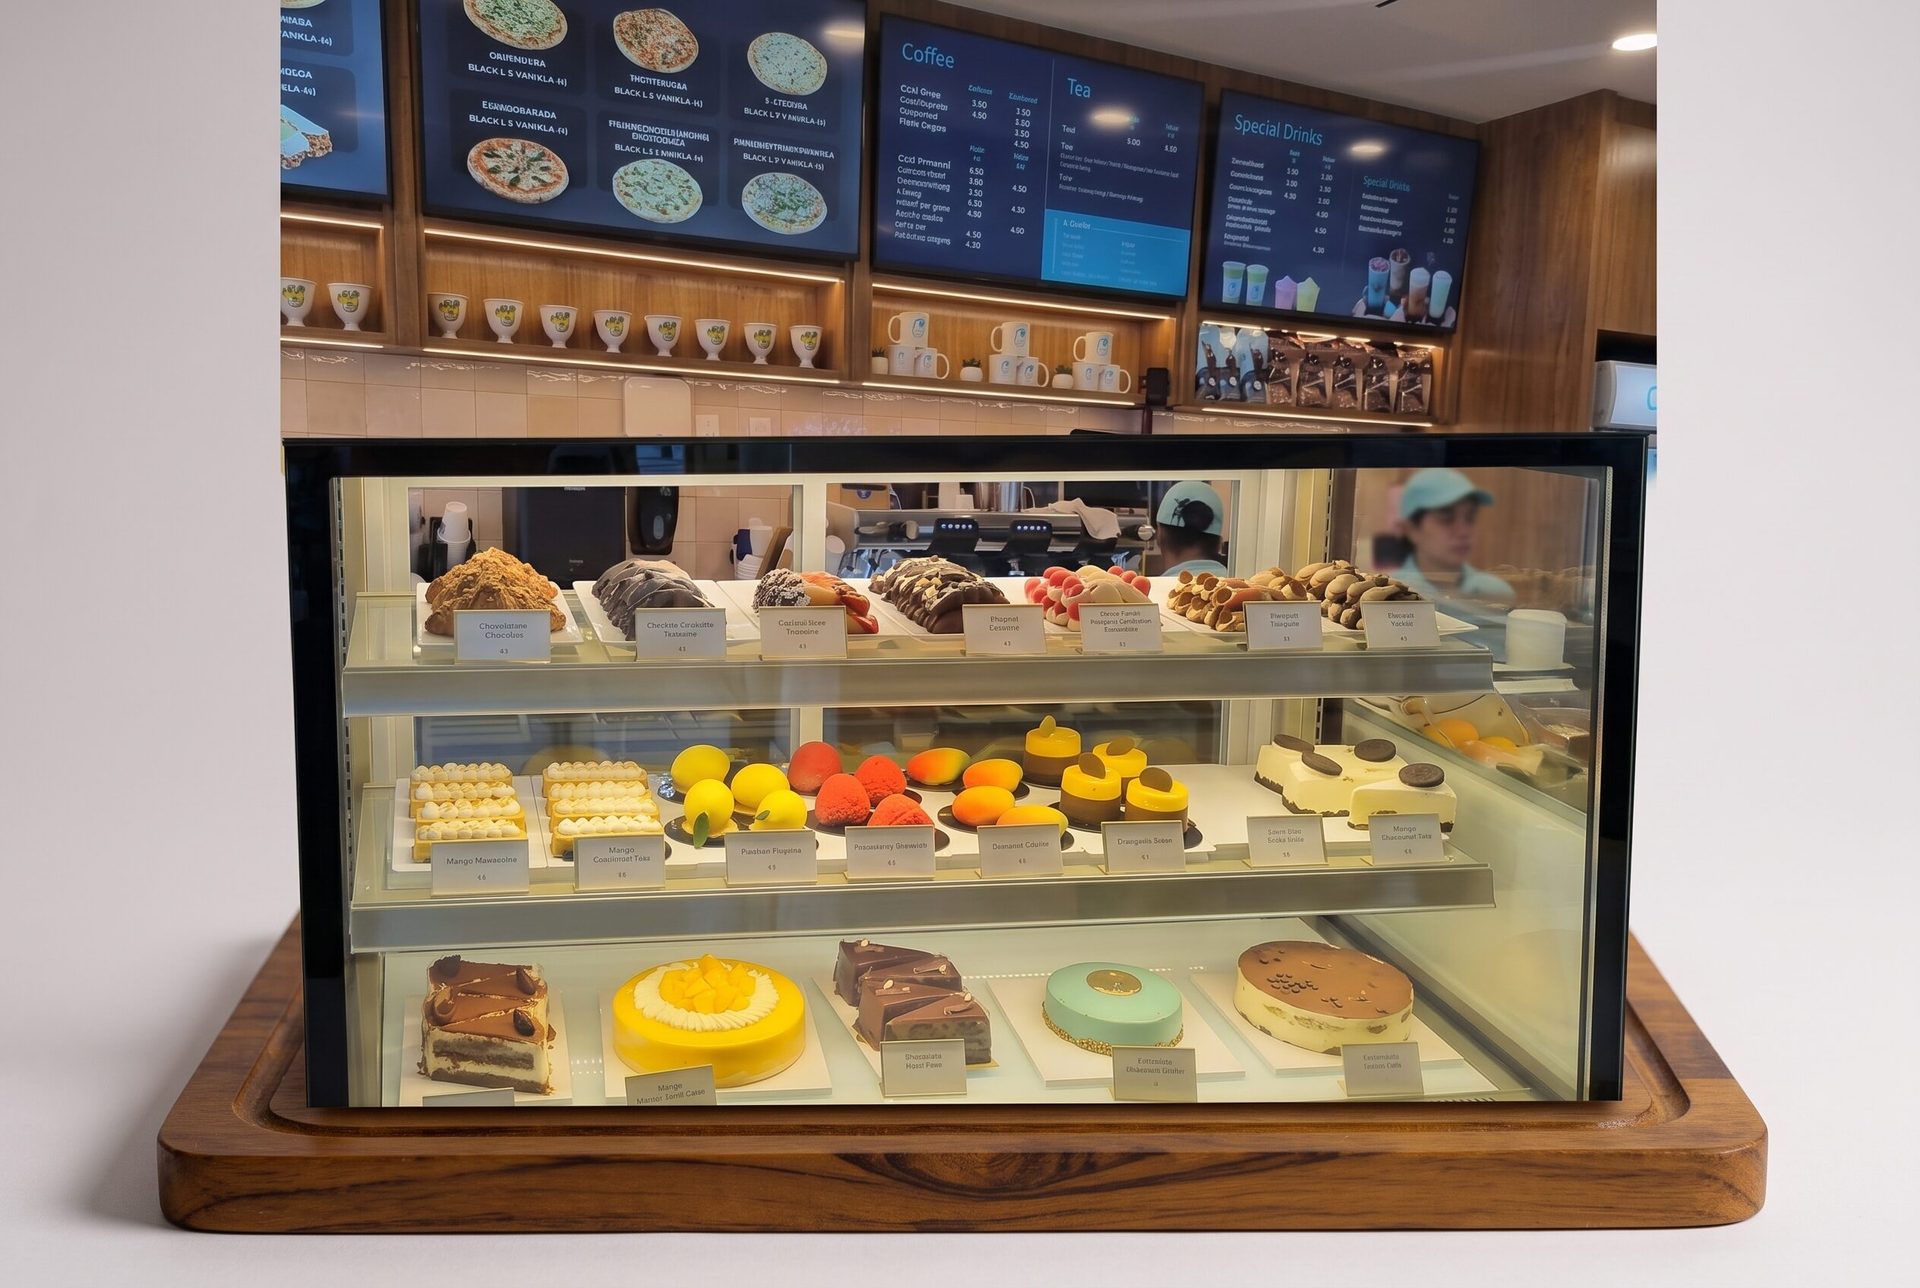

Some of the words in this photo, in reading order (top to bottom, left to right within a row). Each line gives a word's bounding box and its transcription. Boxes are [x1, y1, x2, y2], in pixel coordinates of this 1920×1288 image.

[902, 43, 954, 68] Coffee
[468, 64, 499, 75] BLACK
[614, 87, 641, 97] BLACK
[1067, 78, 1091, 98] Tea
[744, 108, 768, 117] BLACK
[469, 115, 500, 125] BLACK
[1235, 114, 1280, 138] Special
[1284, 124, 1323, 145] Drinks
[615, 144, 641, 154] BLACK
[1014, 140, 1029, 149] 4.50
[743, 153, 766, 163] BLACK
[1363, 176, 1388, 190] Special
[1012, 184, 1027, 193] 4.50
